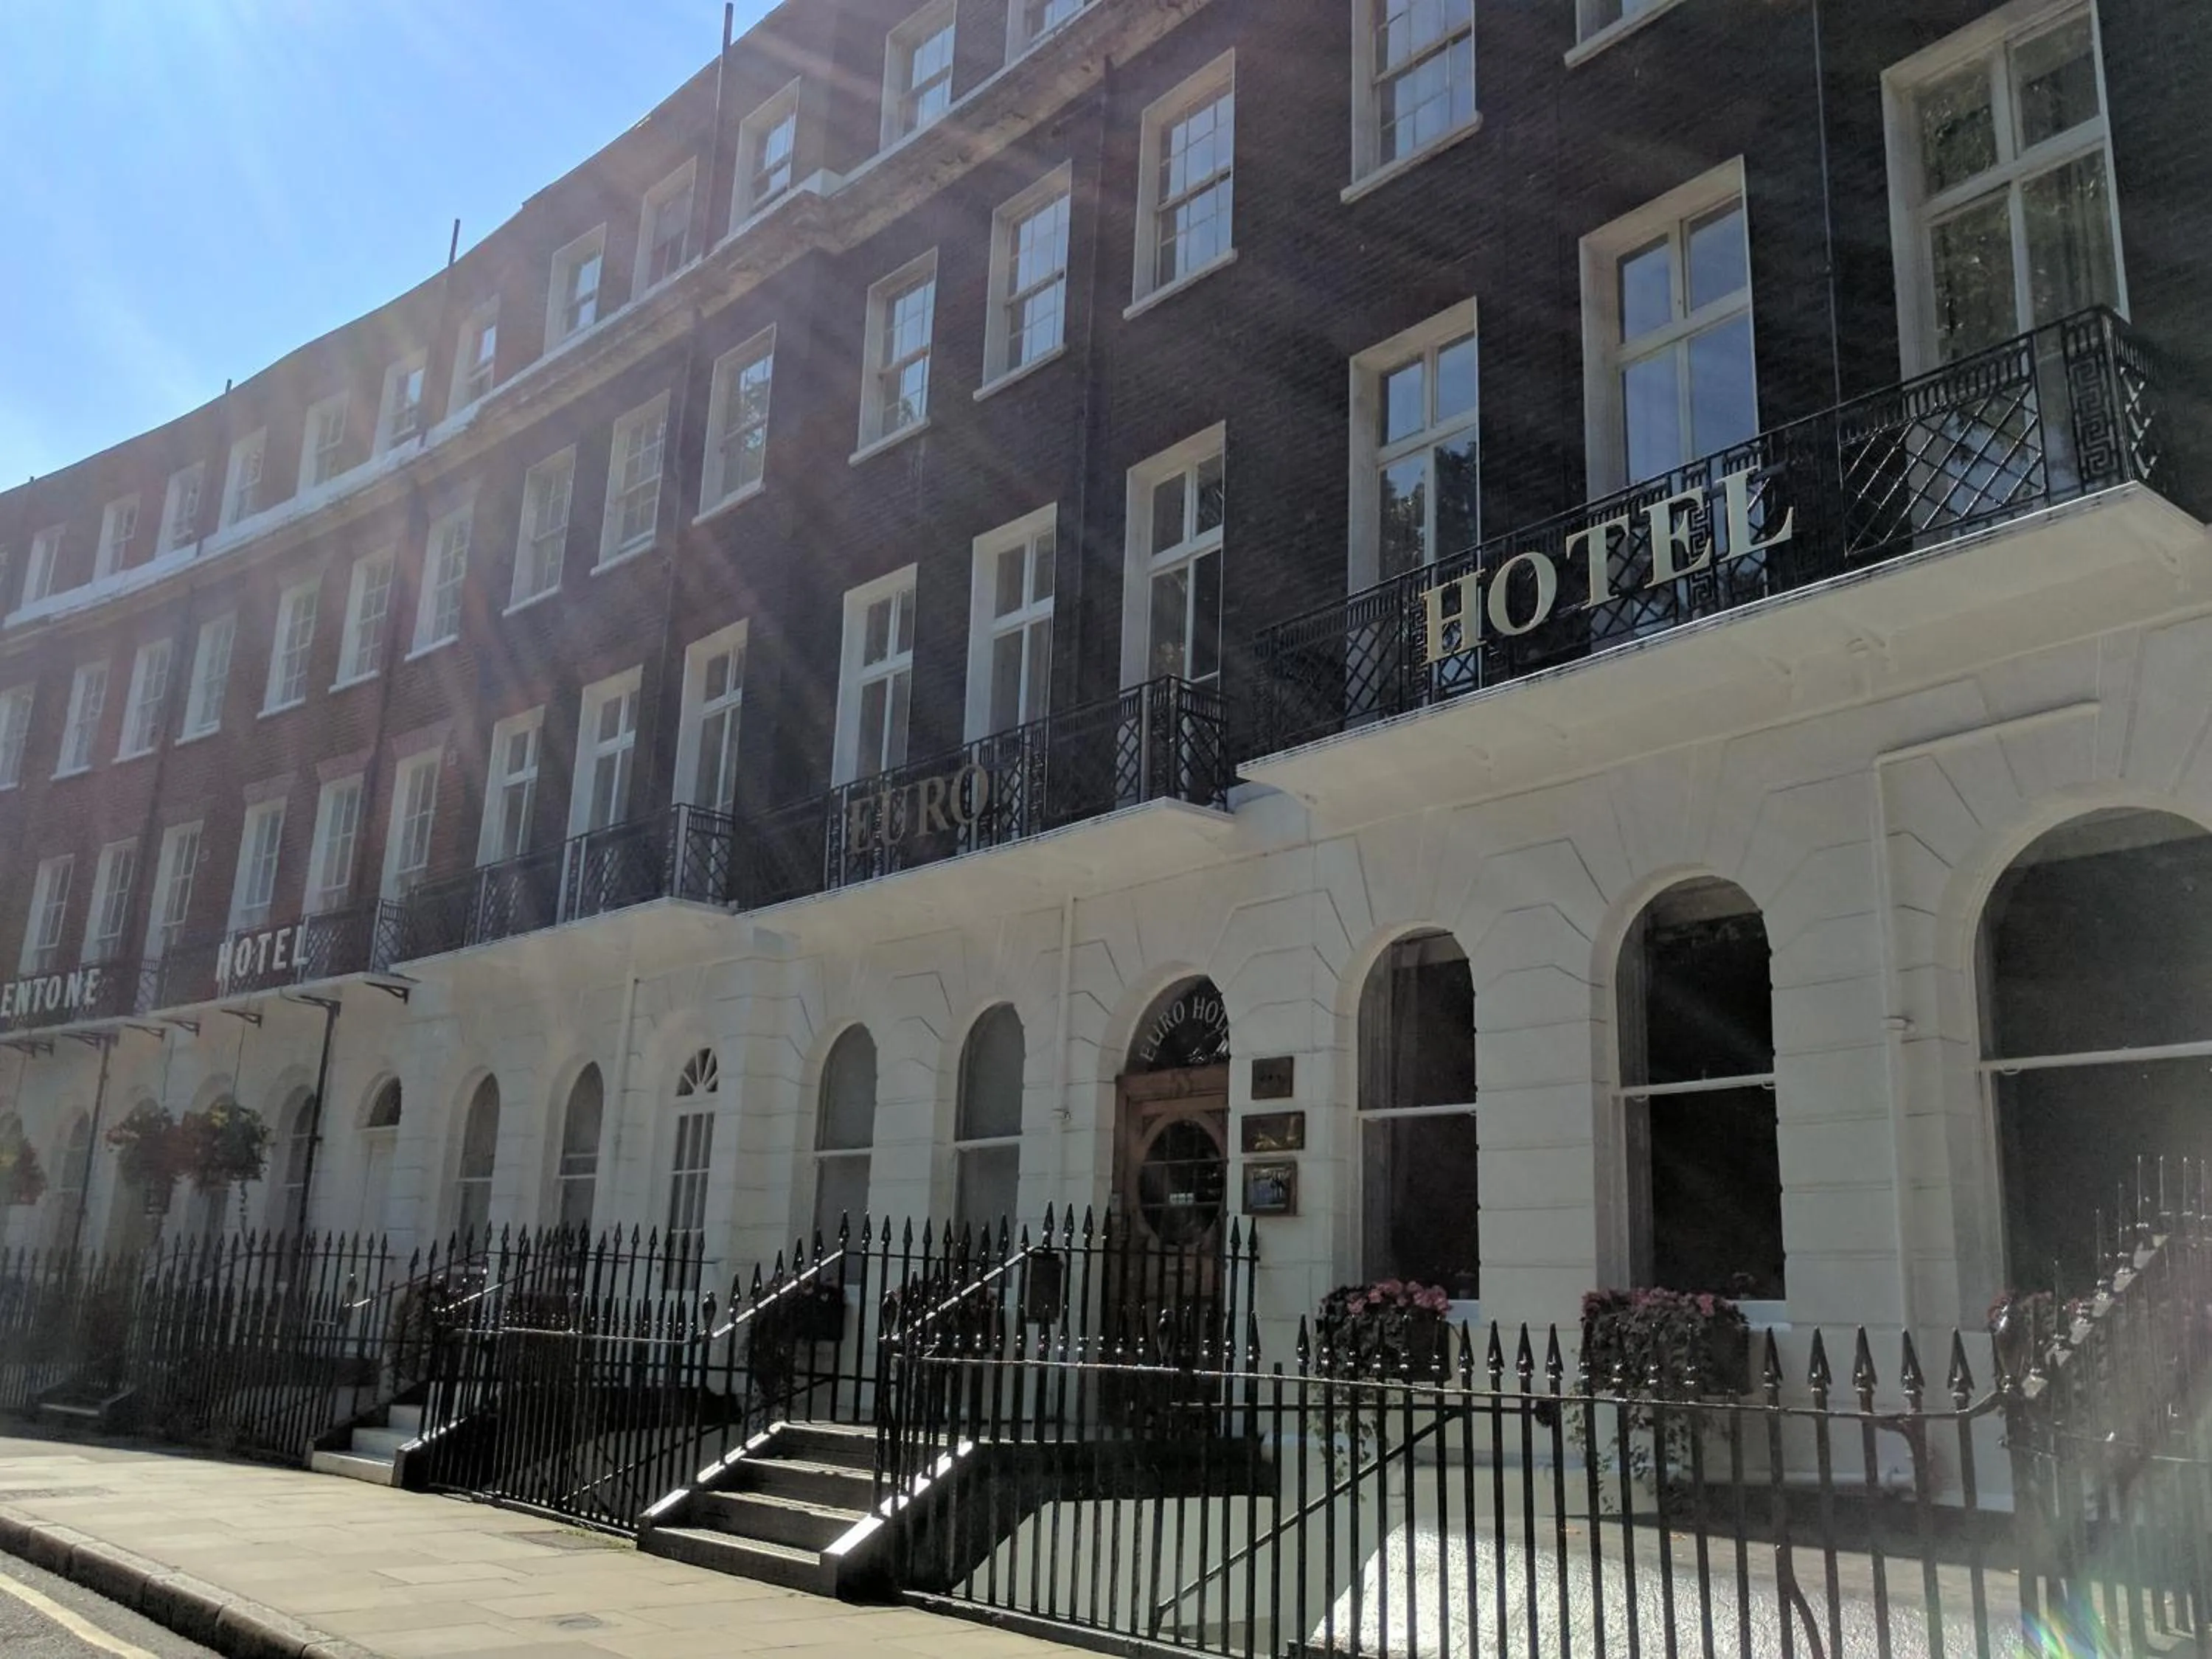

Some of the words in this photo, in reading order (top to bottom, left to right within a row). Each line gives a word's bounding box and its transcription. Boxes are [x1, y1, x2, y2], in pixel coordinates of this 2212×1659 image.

[1419, 464, 1793, 665] HOTEL
[848, 762, 990, 855] EURO
[0, 967, 102, 1018] ENTONE
[215, 925, 311, 983] HOTEL
[1139, 1000, 1185, 1062] EURO
[1192, 995, 1229, 1038] HOT
